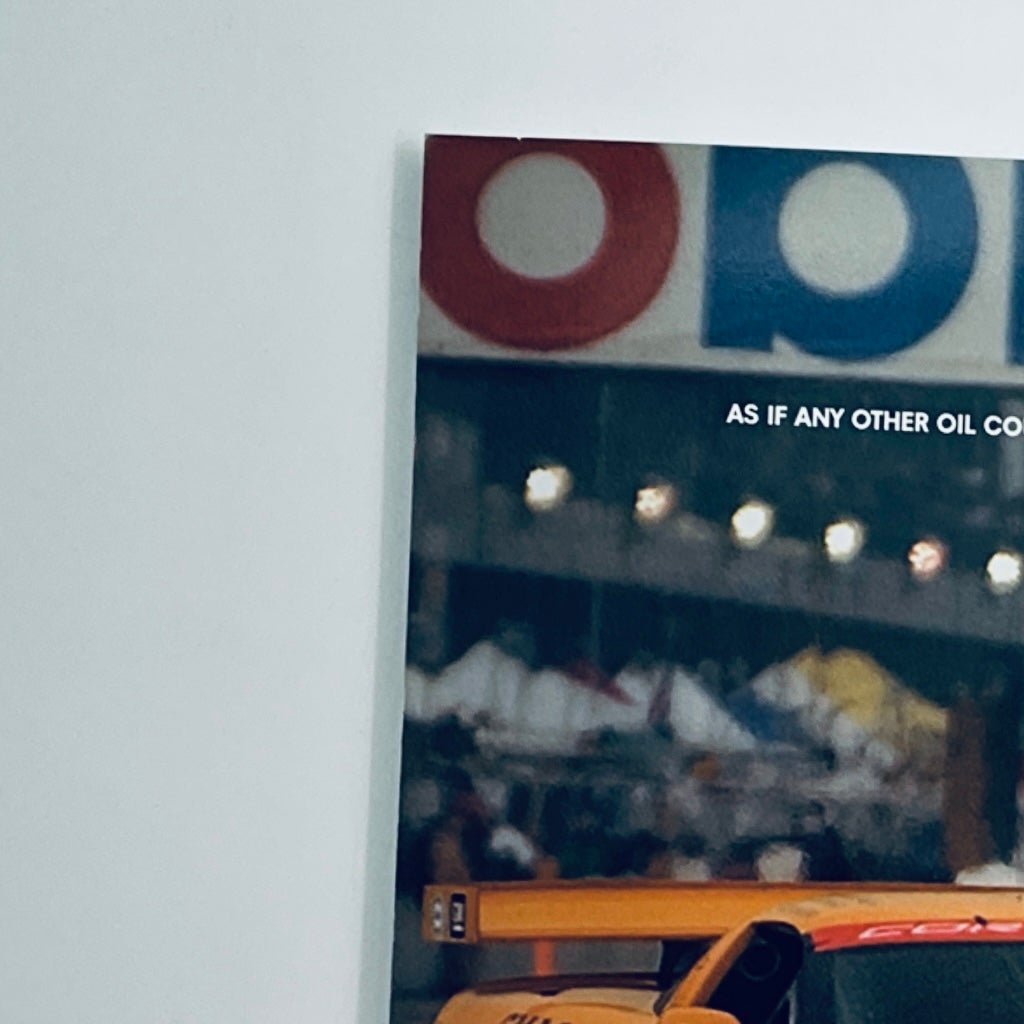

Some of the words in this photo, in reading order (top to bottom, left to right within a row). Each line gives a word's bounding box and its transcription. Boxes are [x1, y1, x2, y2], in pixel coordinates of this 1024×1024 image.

[726, 403, 759, 425] AS
[767, 405, 788, 426] IF
[794, 406, 845, 428] ANY
[851, 409, 929, 433] OTHER
[936, 413, 977, 435] OIL
